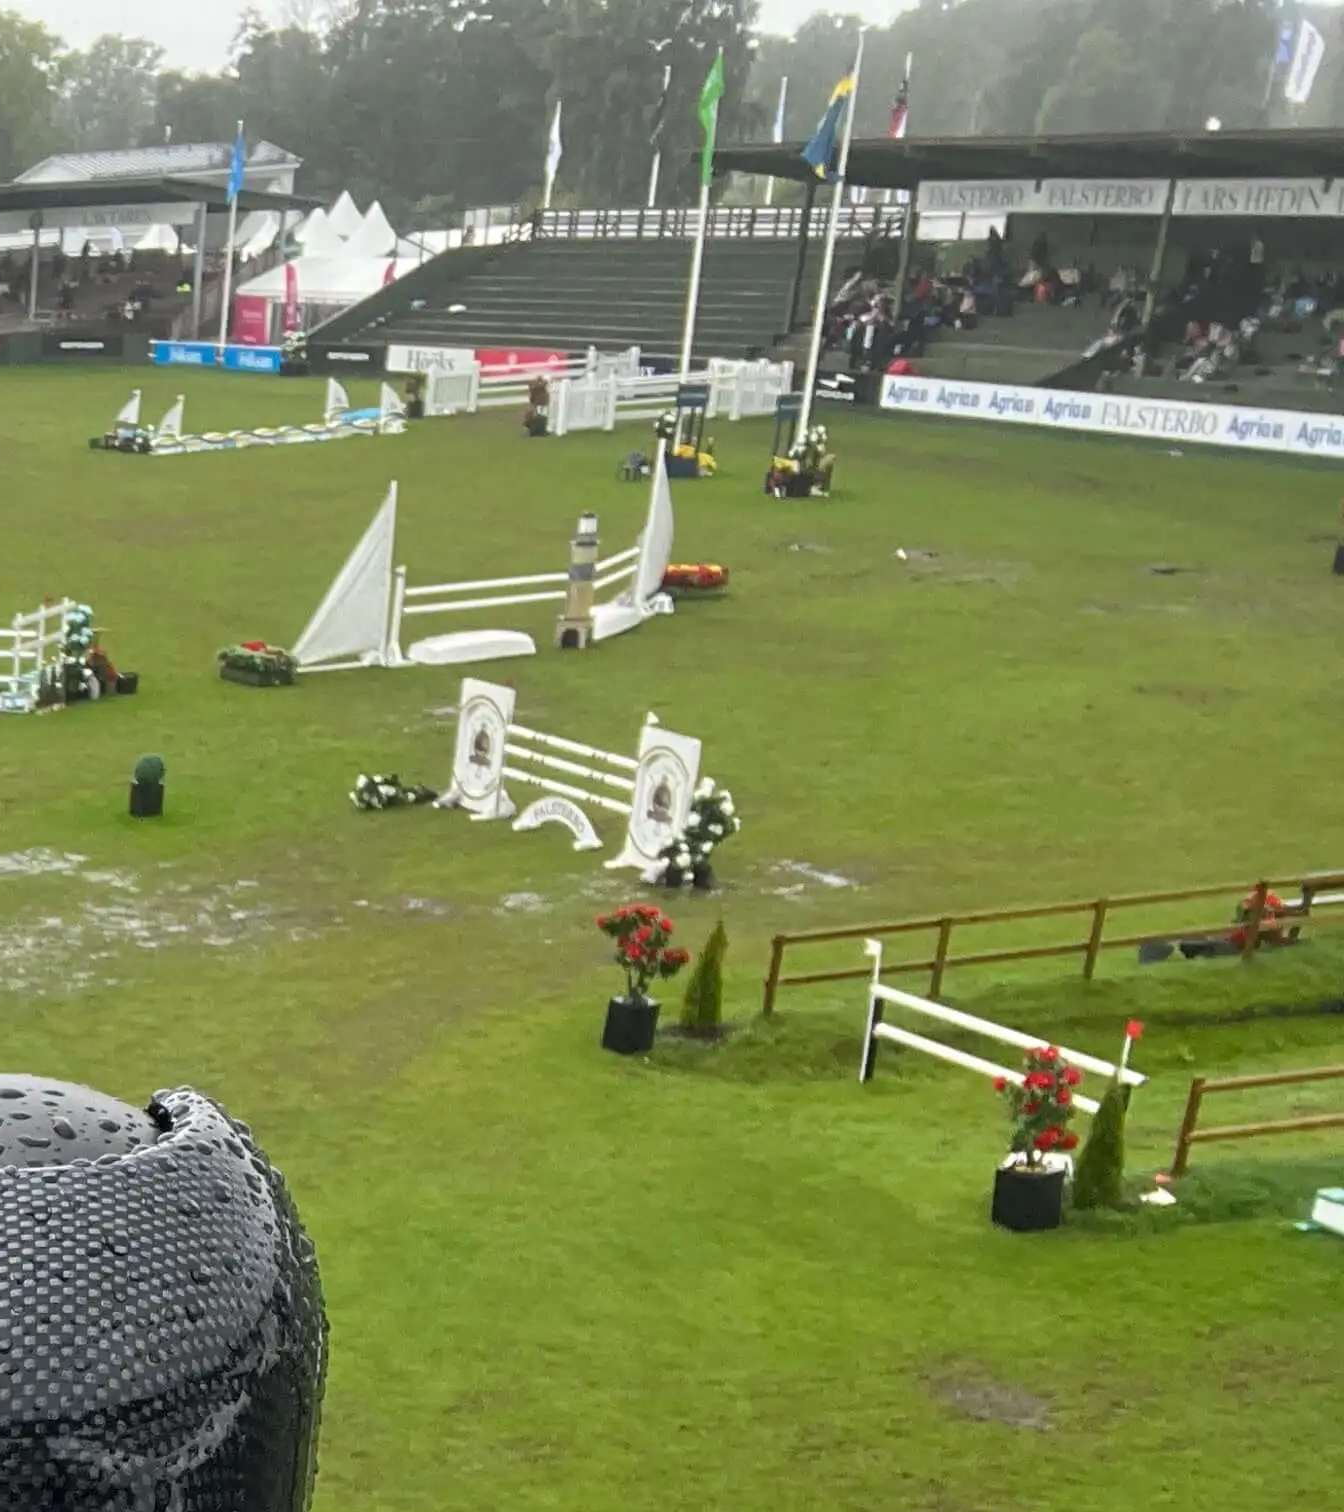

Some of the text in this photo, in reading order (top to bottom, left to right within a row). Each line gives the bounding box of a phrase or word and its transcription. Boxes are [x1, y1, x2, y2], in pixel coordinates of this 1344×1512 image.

[928, 184, 1024, 206] FALSTERBO
[1048, 184, 1154, 207] FALSTERBO
[887, 380, 920, 404] Agria
[936, 386, 971, 409] Agria
[988, 391, 1025, 415] Agria
[1043, 396, 1083, 421] Agria
[1100, 400, 1219, 437] FALSTERBO
[1226, 413, 1273, 441] Agria
